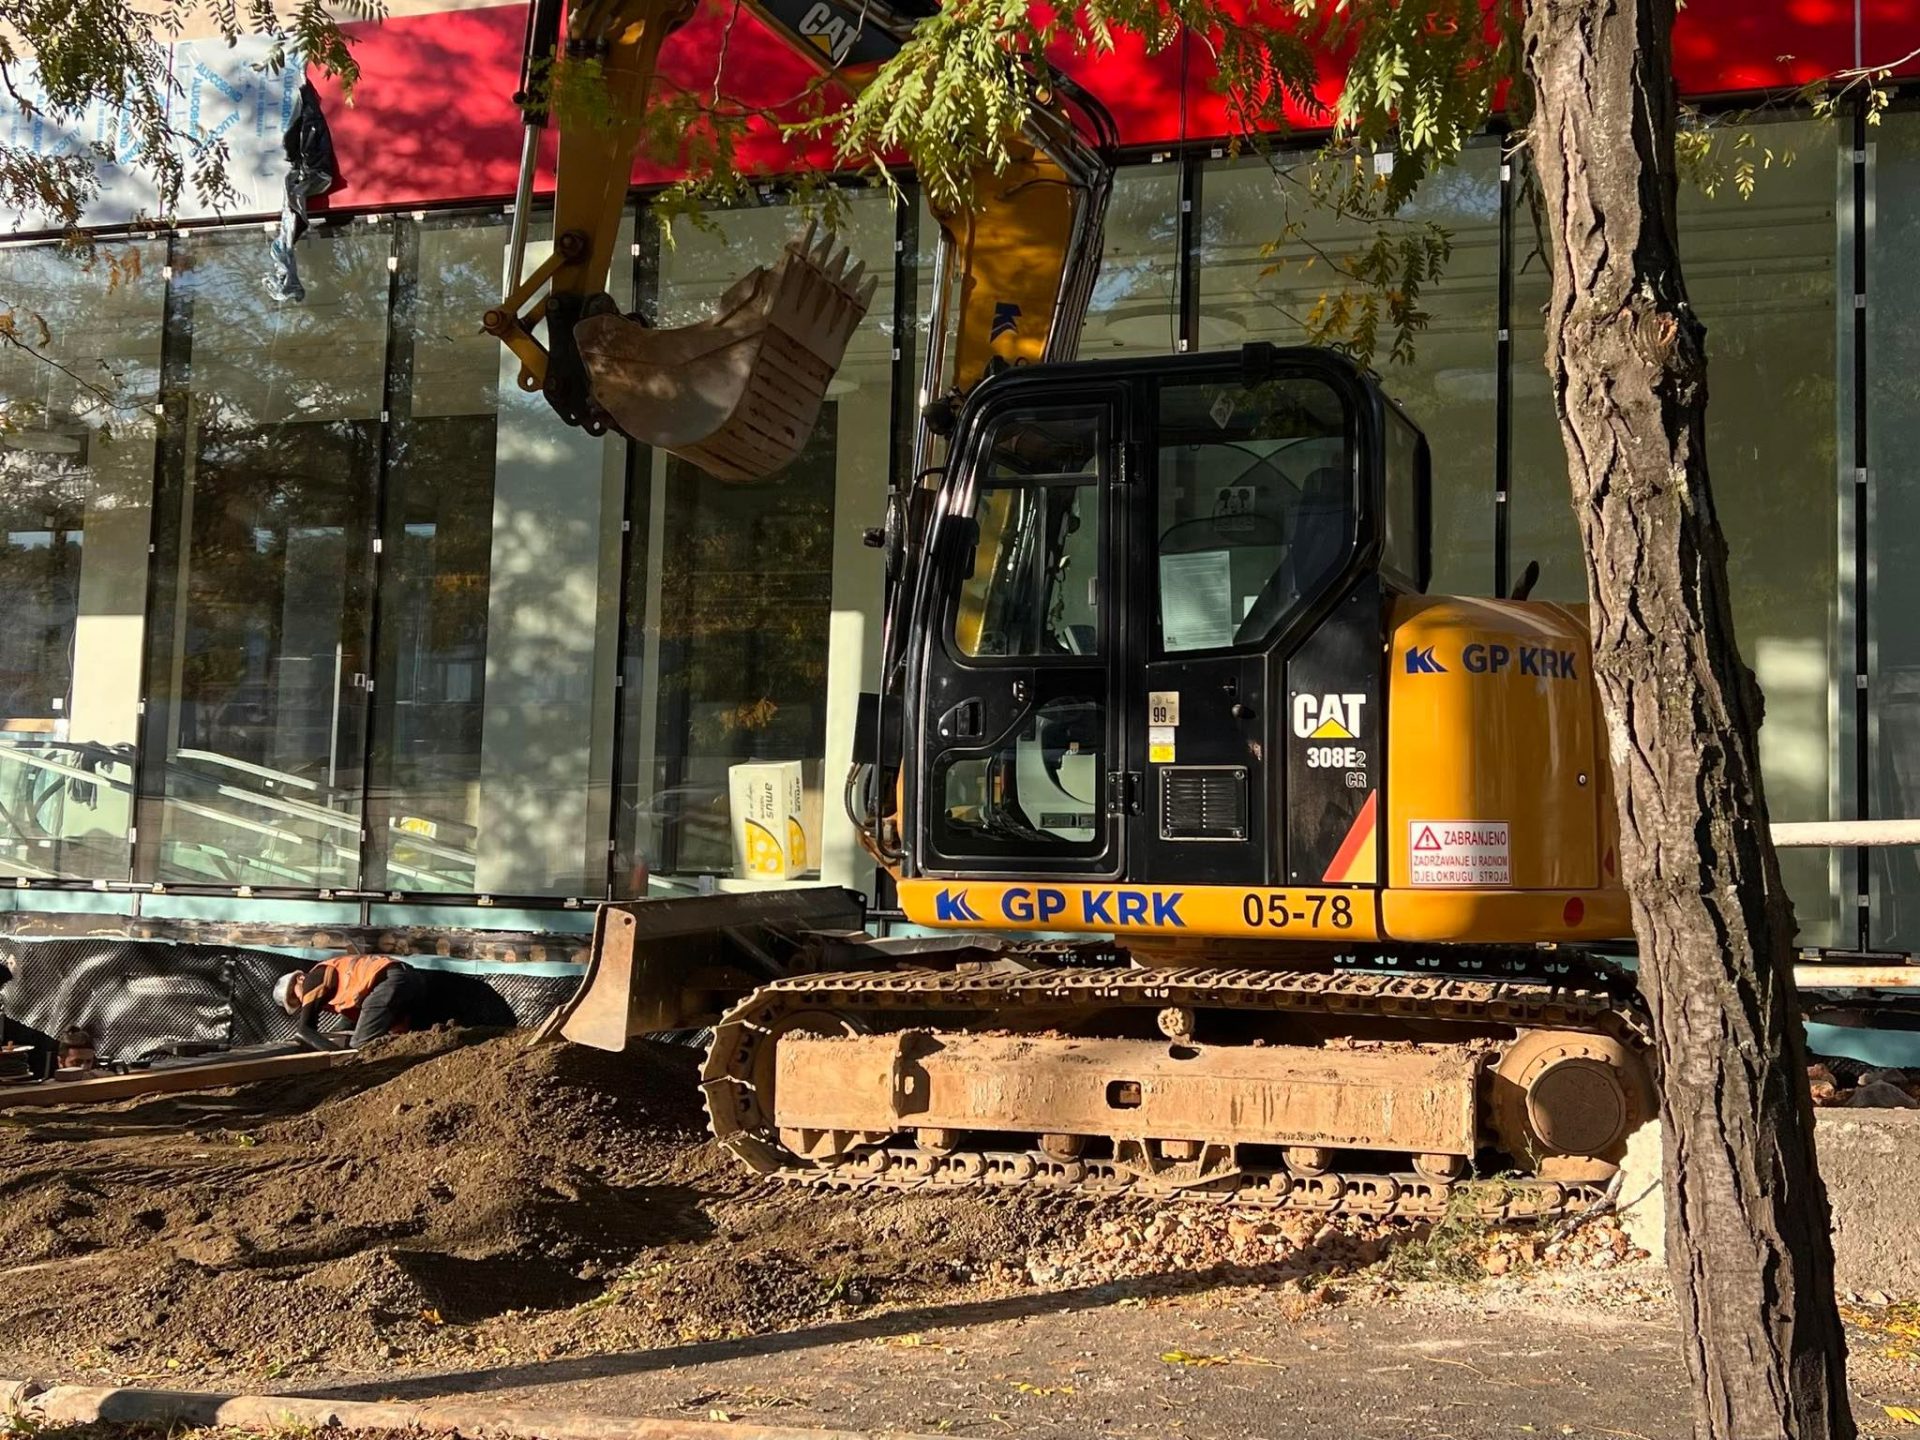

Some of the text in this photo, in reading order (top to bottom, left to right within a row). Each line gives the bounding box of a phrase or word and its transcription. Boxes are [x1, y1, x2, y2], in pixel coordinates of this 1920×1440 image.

[799, 2, 861, 61] CAT
[1463, 643, 1509, 673] GP
[1520, 646, 1578, 680] KRK
[1153, 707, 1167, 723] 99
[1293, 693, 1367, 739] CAT
[1306, 747, 1367, 768] 308E2
[1345, 771, 1367, 788] CR
[1444, 831, 1507, 846] ZABRANJENO
[1413, 853, 1508, 867] ZADRŽAVANJE U RADNOM
[1414, 870, 1508, 882] DJELOKRUGU STROJA
[1001, 888, 1067, 922] GP
[1082, 890, 1188, 928] KRK
[1242, 893, 1354, 929] 05-78
